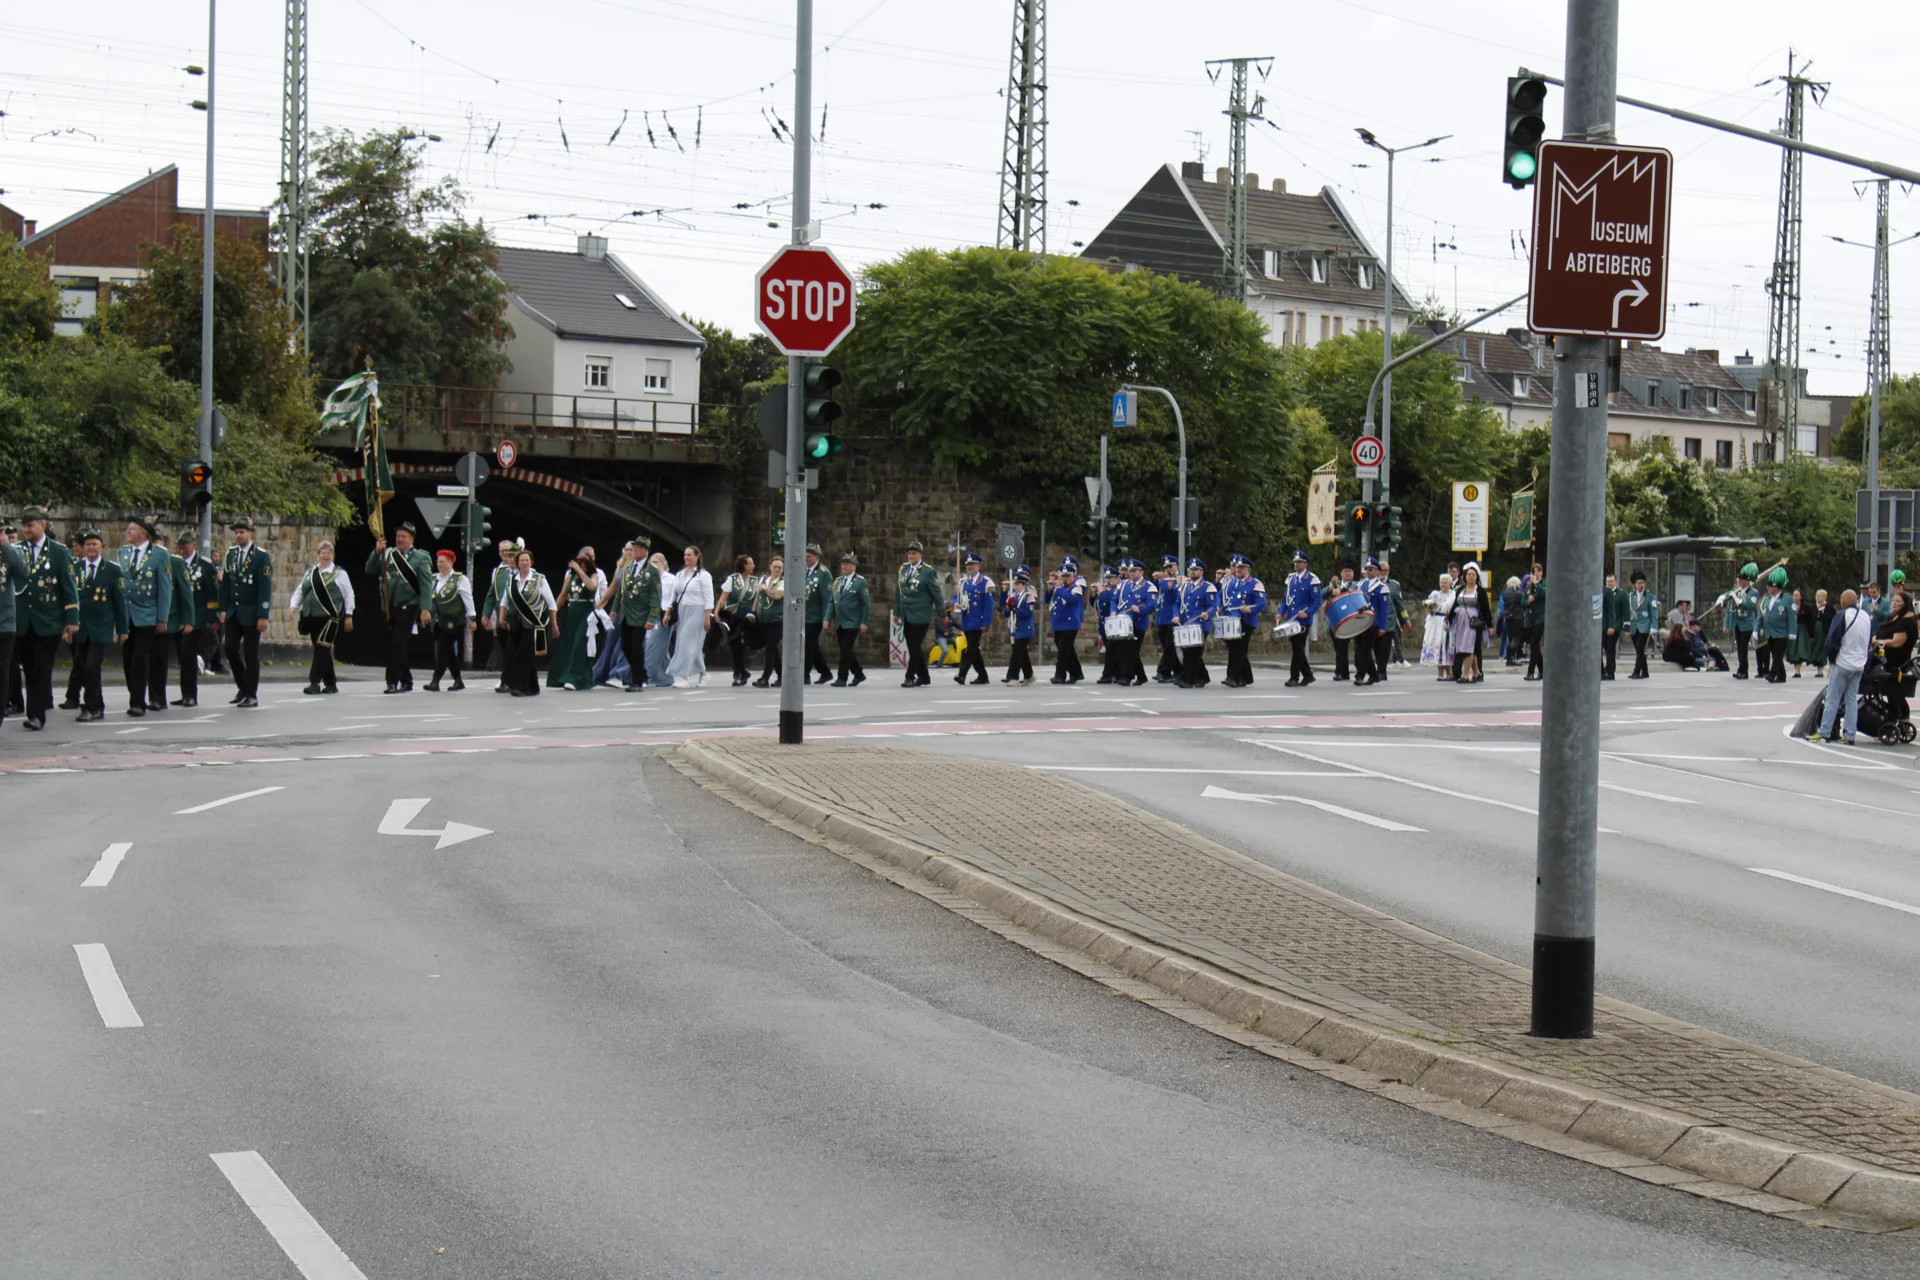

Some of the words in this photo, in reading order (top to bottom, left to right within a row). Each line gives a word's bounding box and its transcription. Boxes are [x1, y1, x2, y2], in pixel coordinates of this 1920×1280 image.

[1565, 252, 1651, 276] ABTEIBERG
[766, 279, 845, 322] STOP
[1359, 445, 1378, 460] 40
